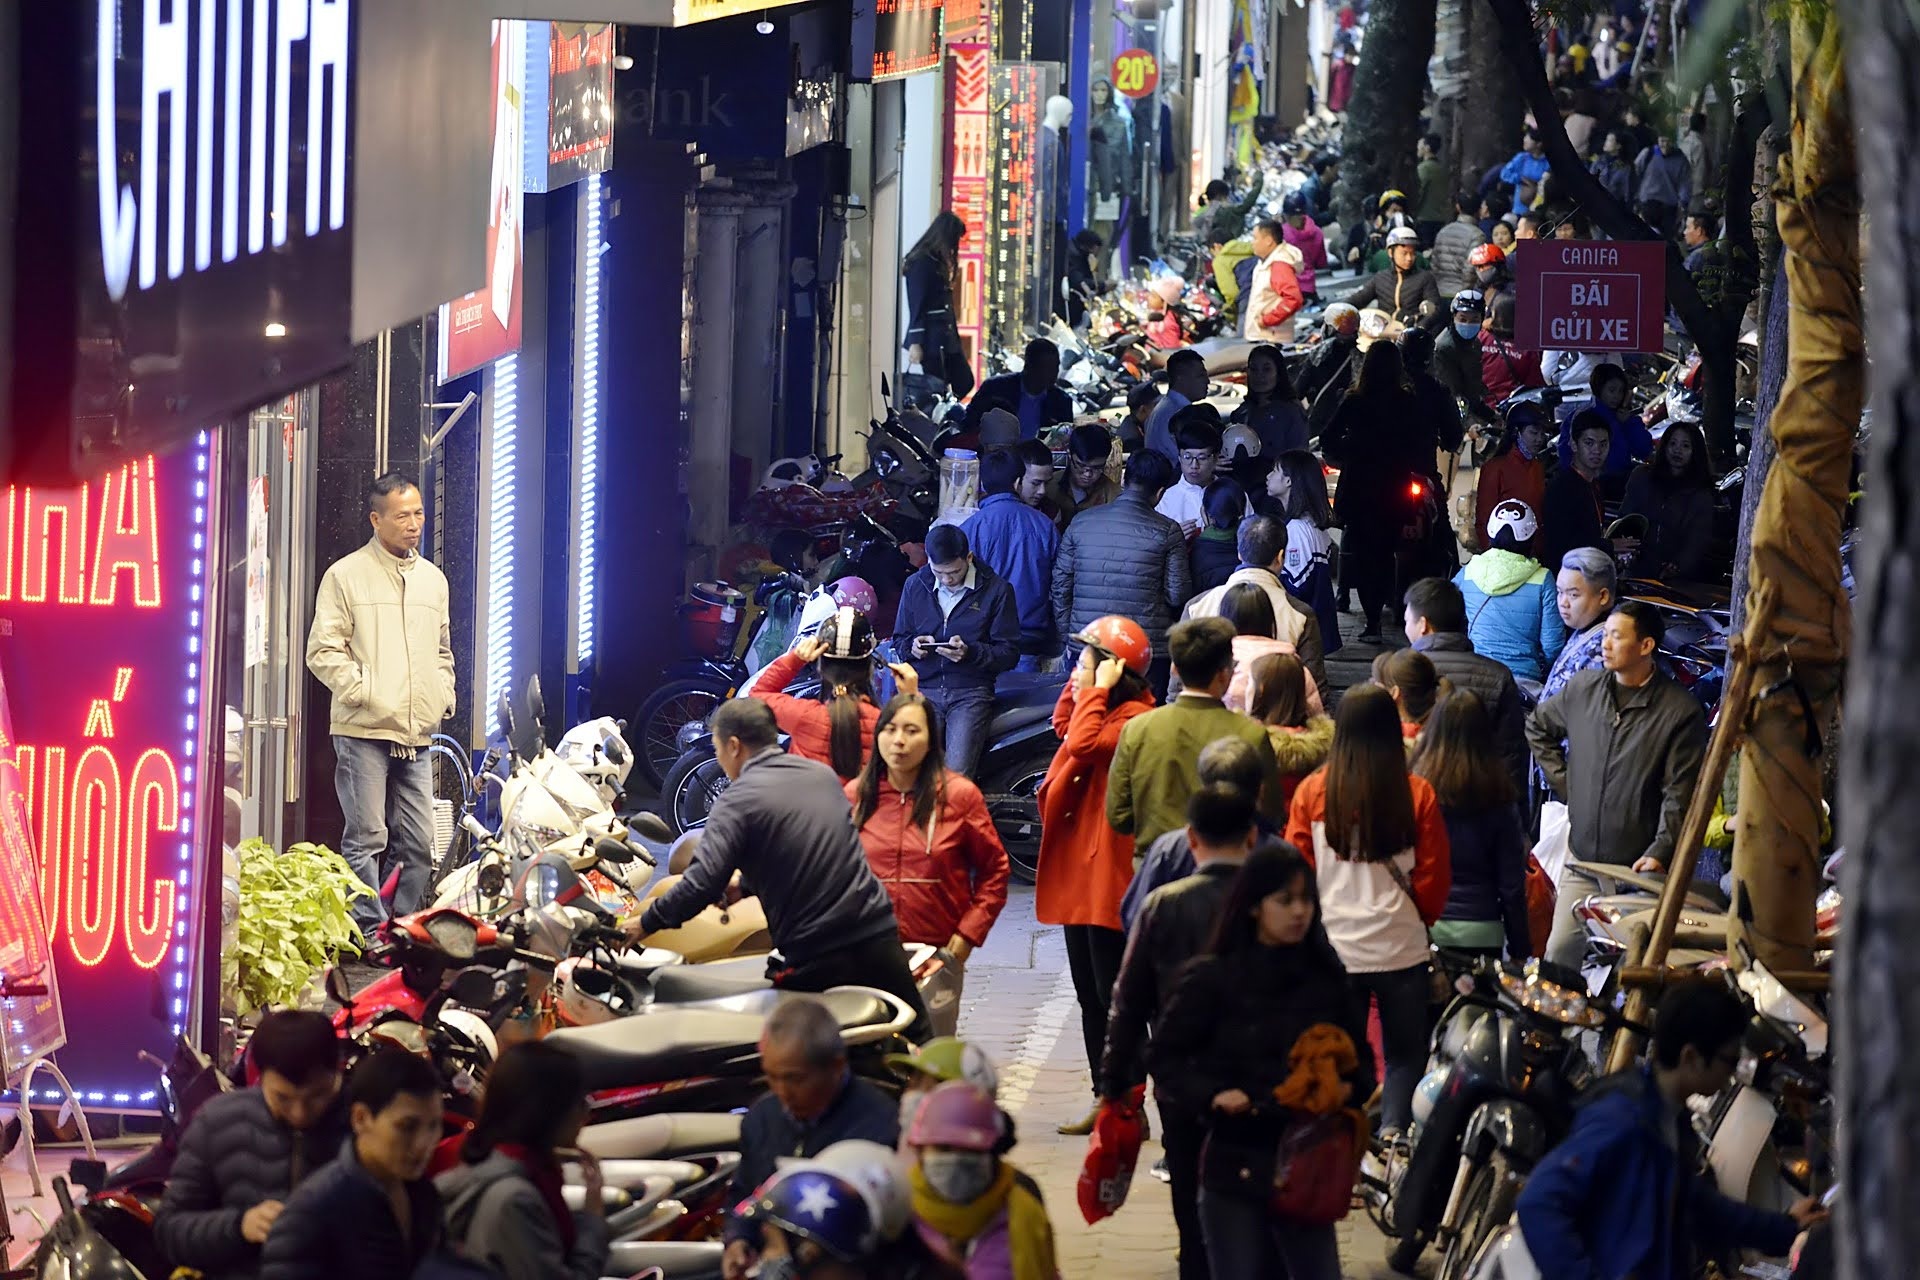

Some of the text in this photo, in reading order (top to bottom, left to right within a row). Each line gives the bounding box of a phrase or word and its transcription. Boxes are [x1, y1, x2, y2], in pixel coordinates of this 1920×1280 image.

[1117, 55, 1155, 91] 20%
[1562, 248, 1618, 265] CANIFA
[1571, 279, 1610, 306] BÃI
[1551, 311, 1629, 341] GỬI XE
